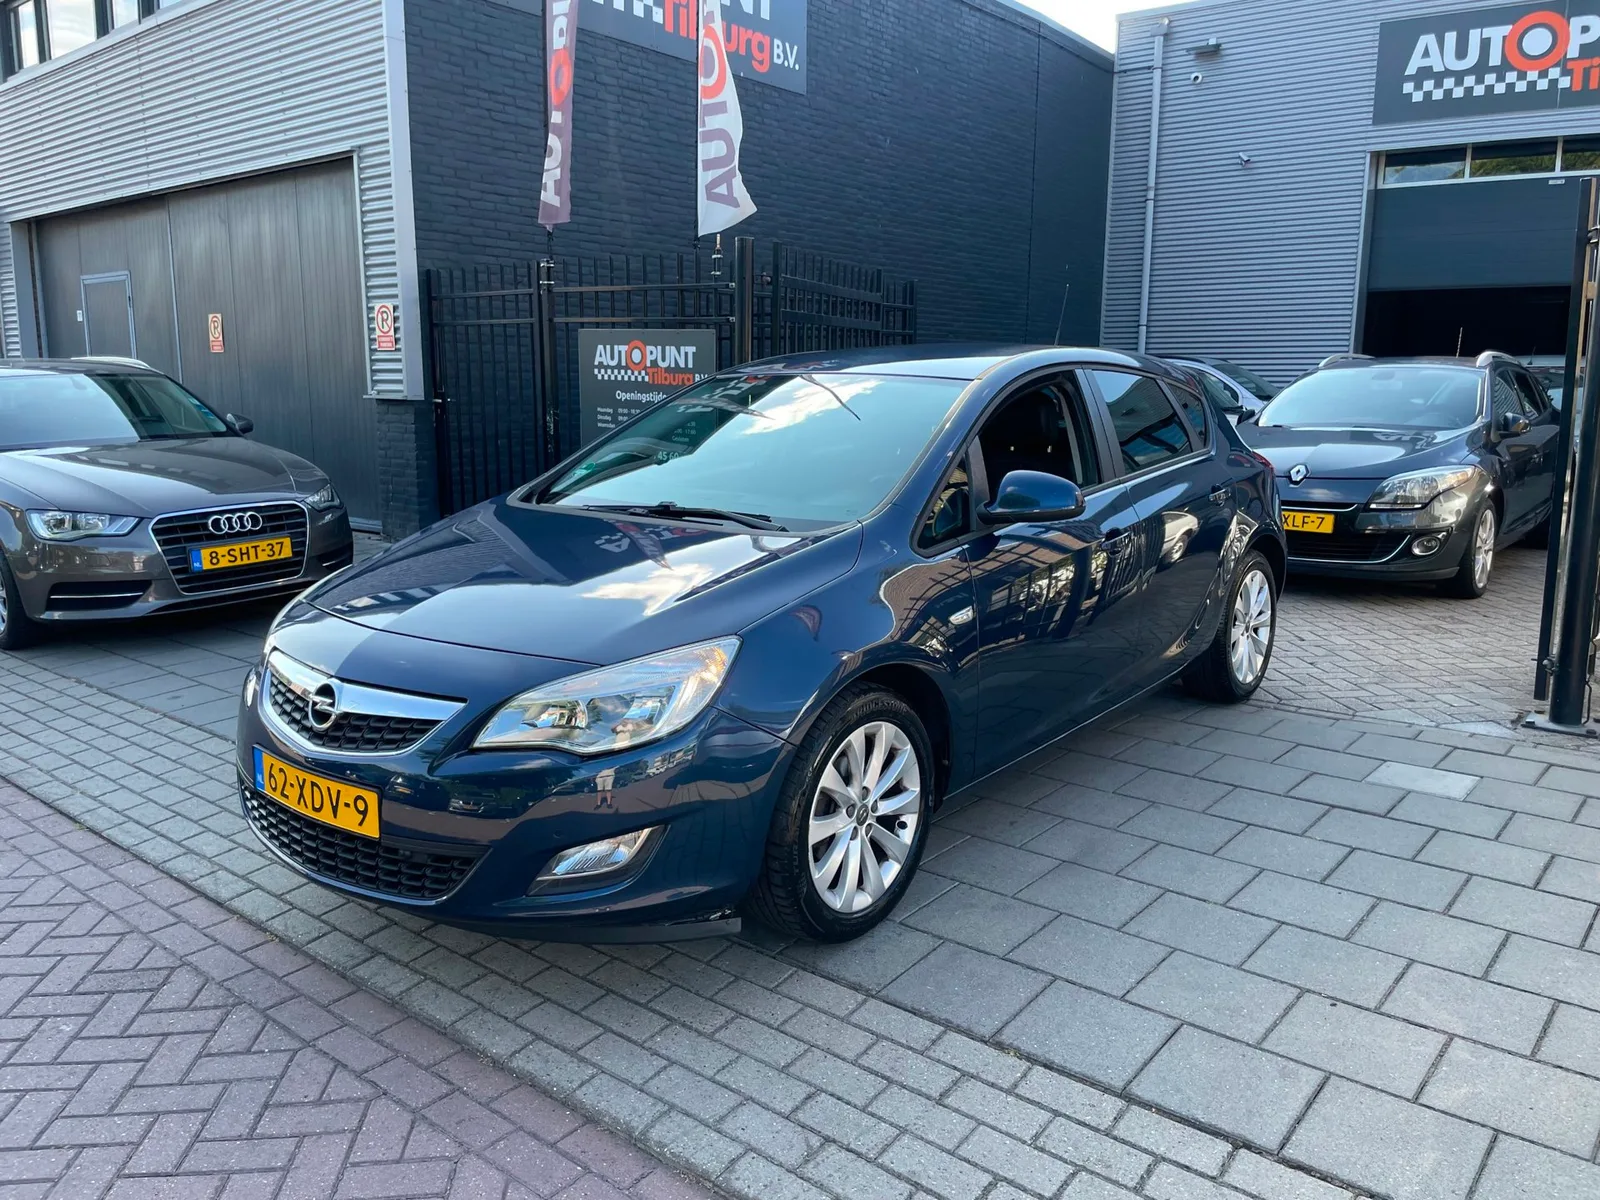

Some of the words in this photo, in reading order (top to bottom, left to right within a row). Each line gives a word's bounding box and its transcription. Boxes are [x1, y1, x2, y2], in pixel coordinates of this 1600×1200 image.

[773, 38, 799, 71] B.V.
[594, 340, 696, 369] AUTOPUNT
[209, 541, 284, 566] 8-SHT-37
[268, 762, 369, 827] 62-XDV-9
